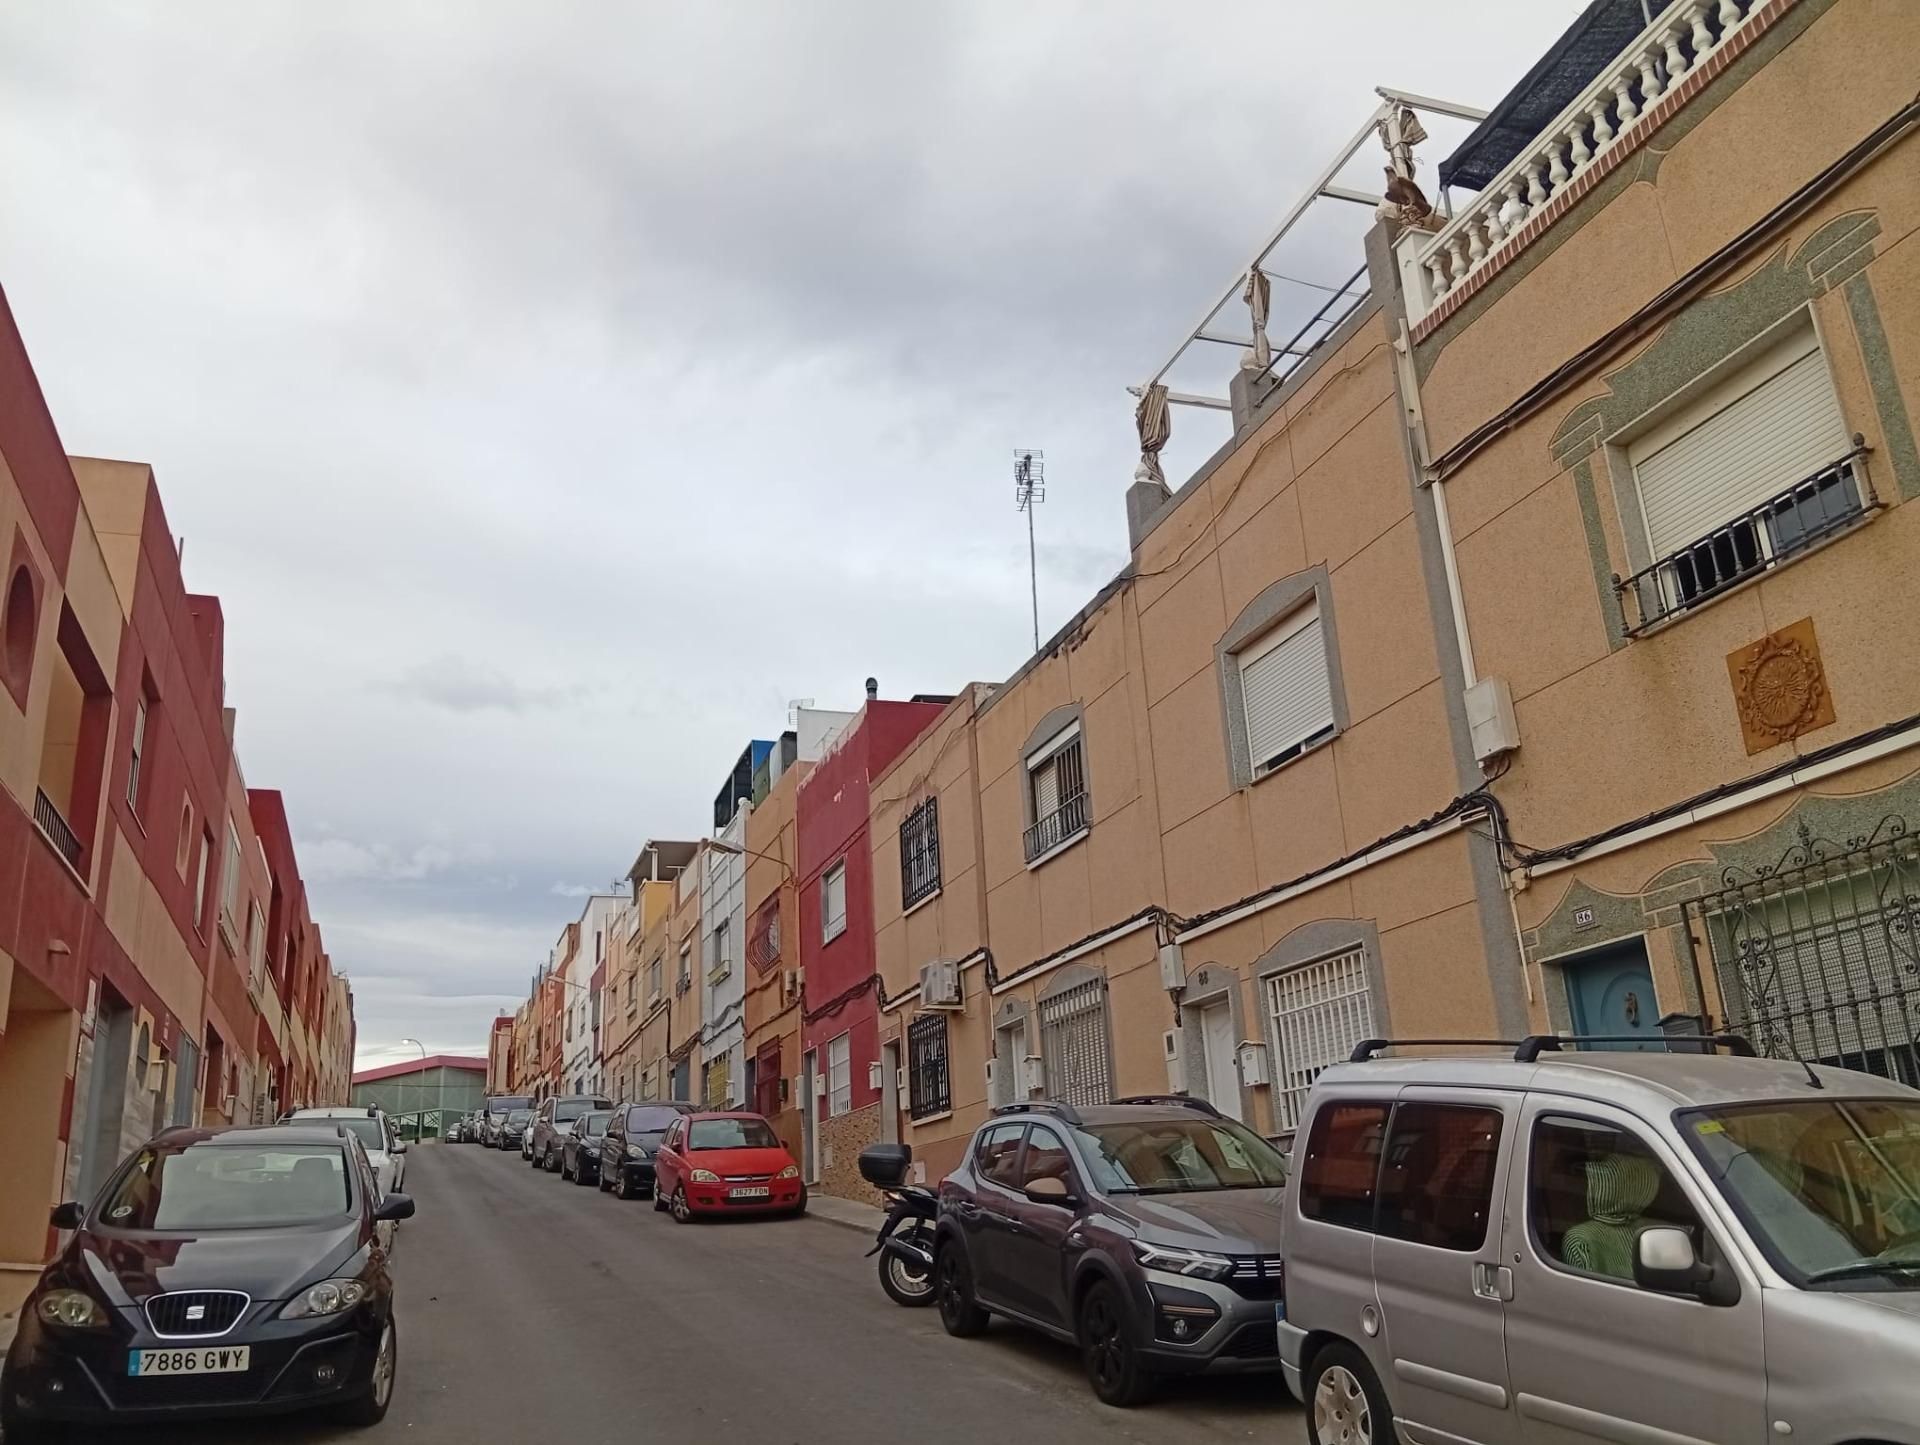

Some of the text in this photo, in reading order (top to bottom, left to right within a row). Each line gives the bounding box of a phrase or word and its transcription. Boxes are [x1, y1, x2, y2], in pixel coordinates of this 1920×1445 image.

[1578, 912, 1590, 922] 86
[143, 1349, 243, 1372] 7886 GWY
